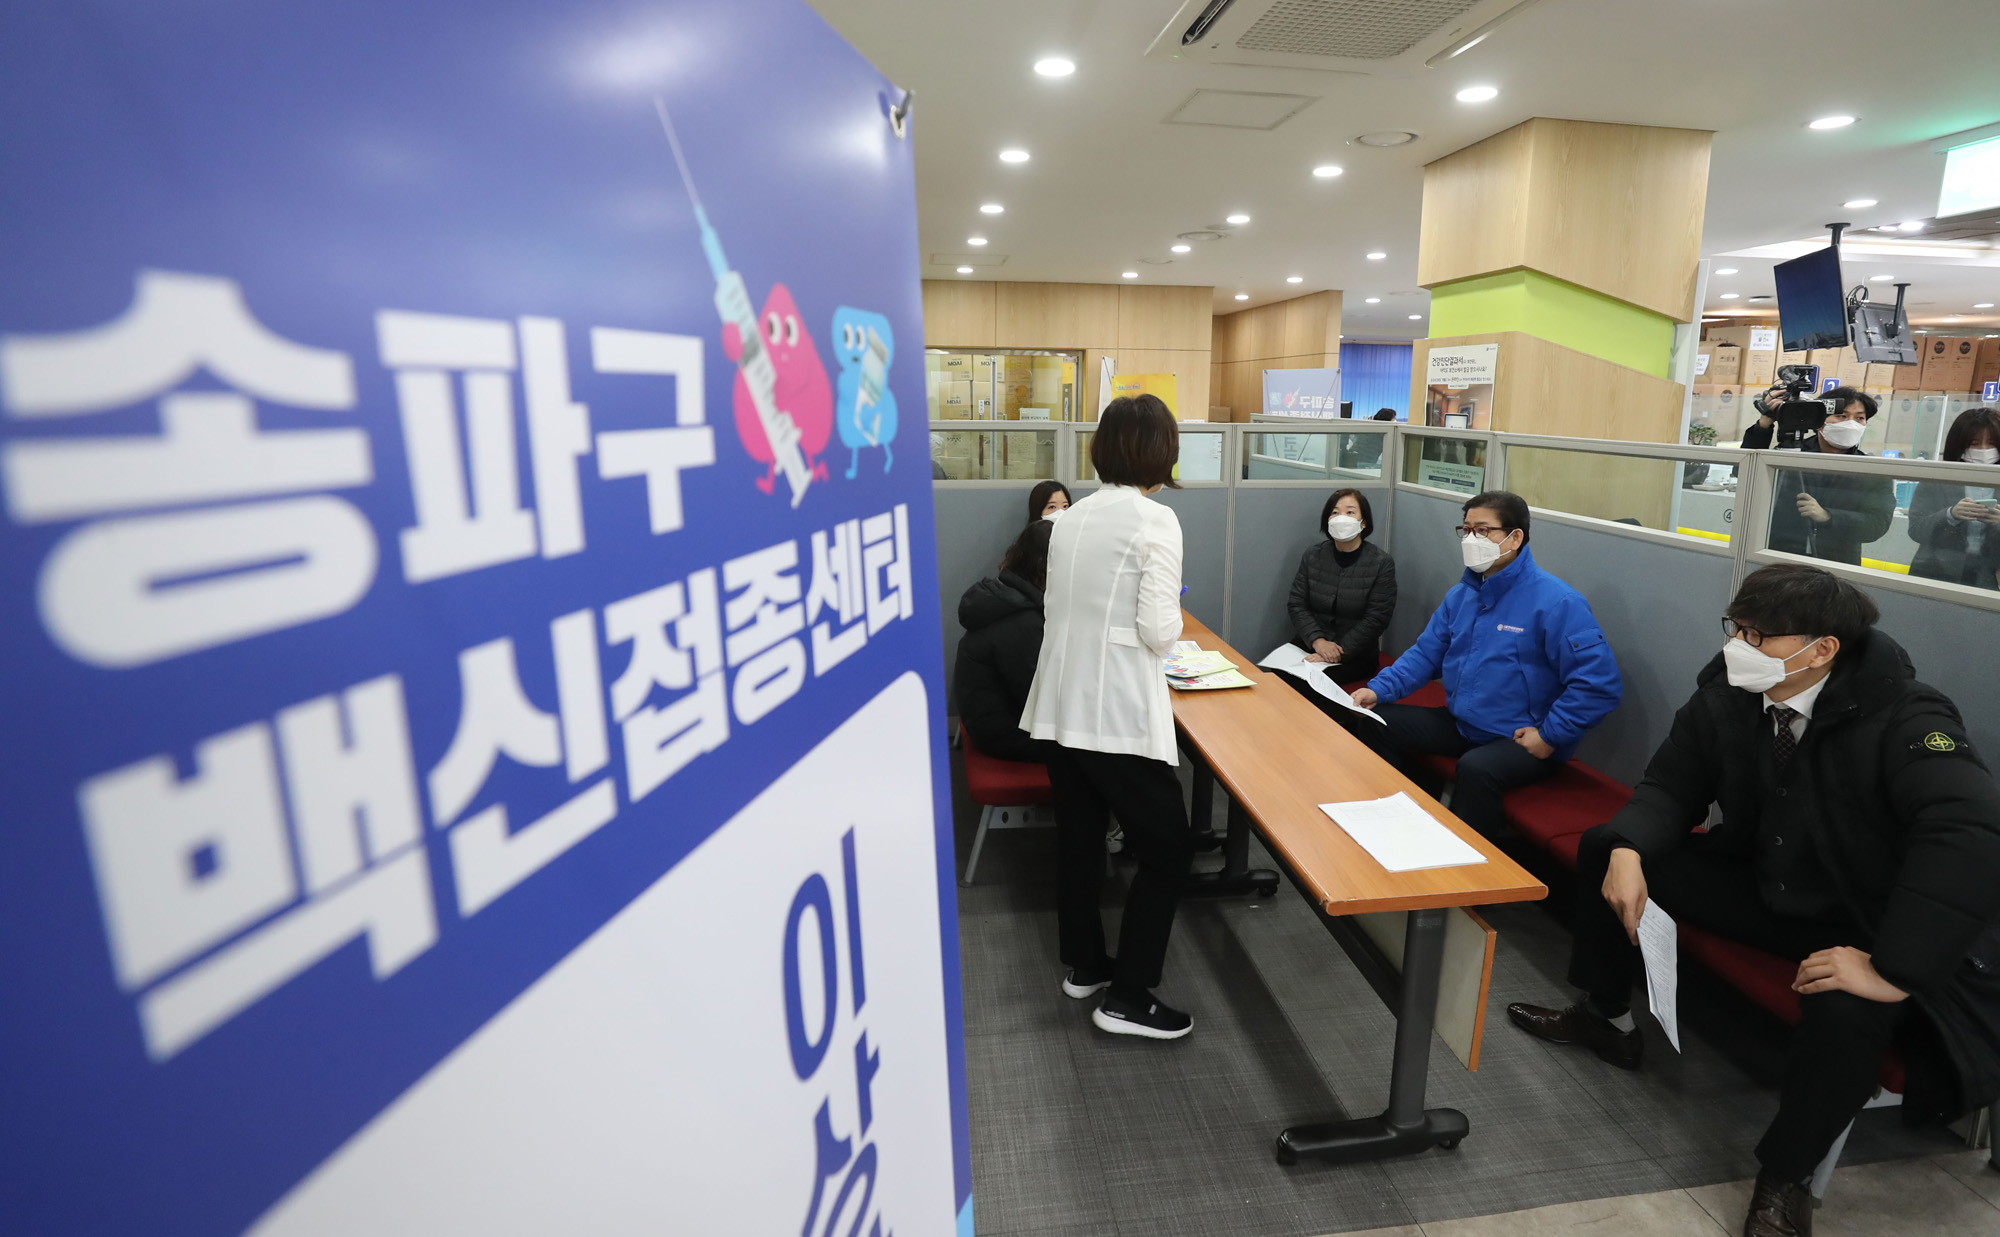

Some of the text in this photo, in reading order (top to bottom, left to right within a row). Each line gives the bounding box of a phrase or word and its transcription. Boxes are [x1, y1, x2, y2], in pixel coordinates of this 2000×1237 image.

[0, 268, 714, 669] 송파구
[1987, 384, 1994, 399] 1
[78, 503, 913, 1063] 백신접종센터
[783, 825, 894, 1237] 이상
